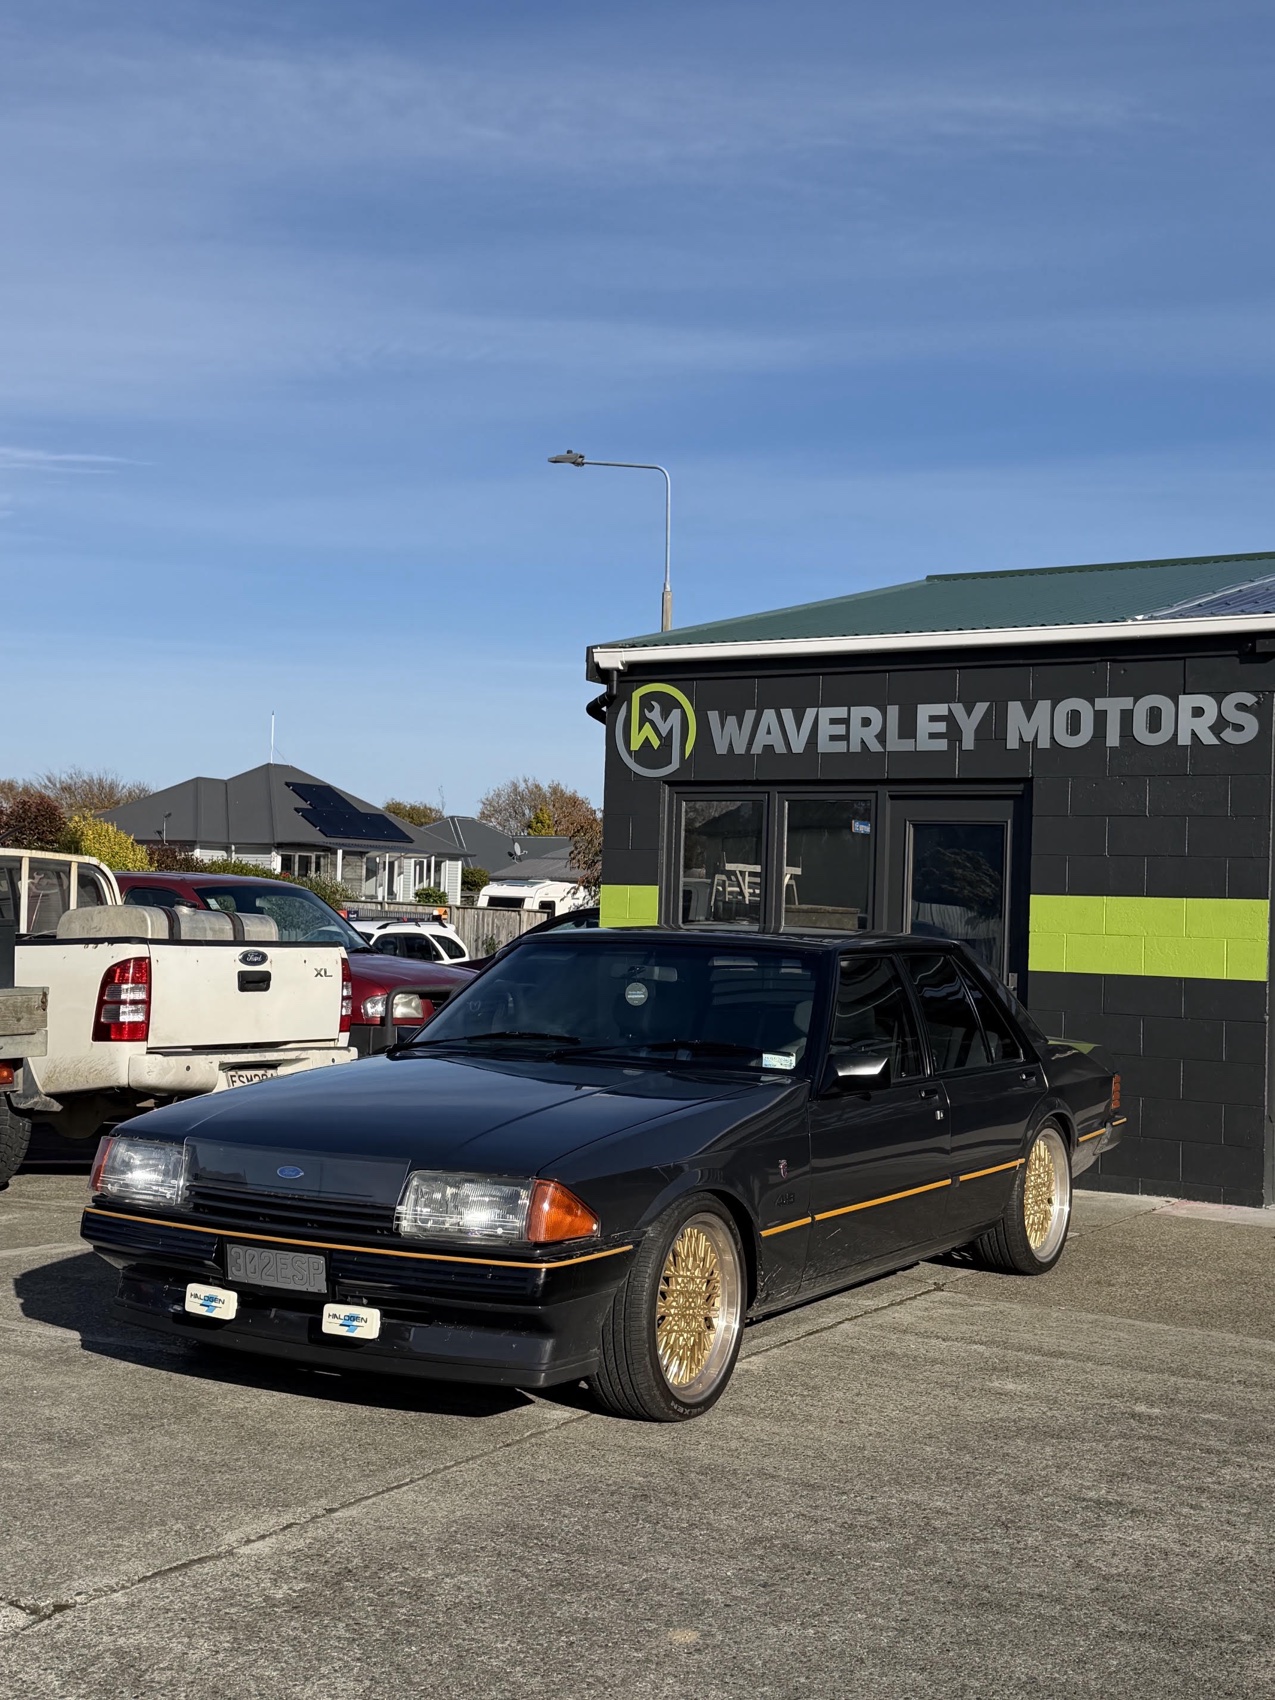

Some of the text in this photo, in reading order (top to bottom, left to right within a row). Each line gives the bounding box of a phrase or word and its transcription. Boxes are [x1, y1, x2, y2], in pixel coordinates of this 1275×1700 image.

[707, 691, 1260, 756] WAVERLEY MOTORS
[314, 968, 333, 978] XL
[230, 1246, 324, 1288] 302ESP
[190, 1292, 226, 1305] HALOGEN
[328, 1312, 368, 1324] HALOGEN
